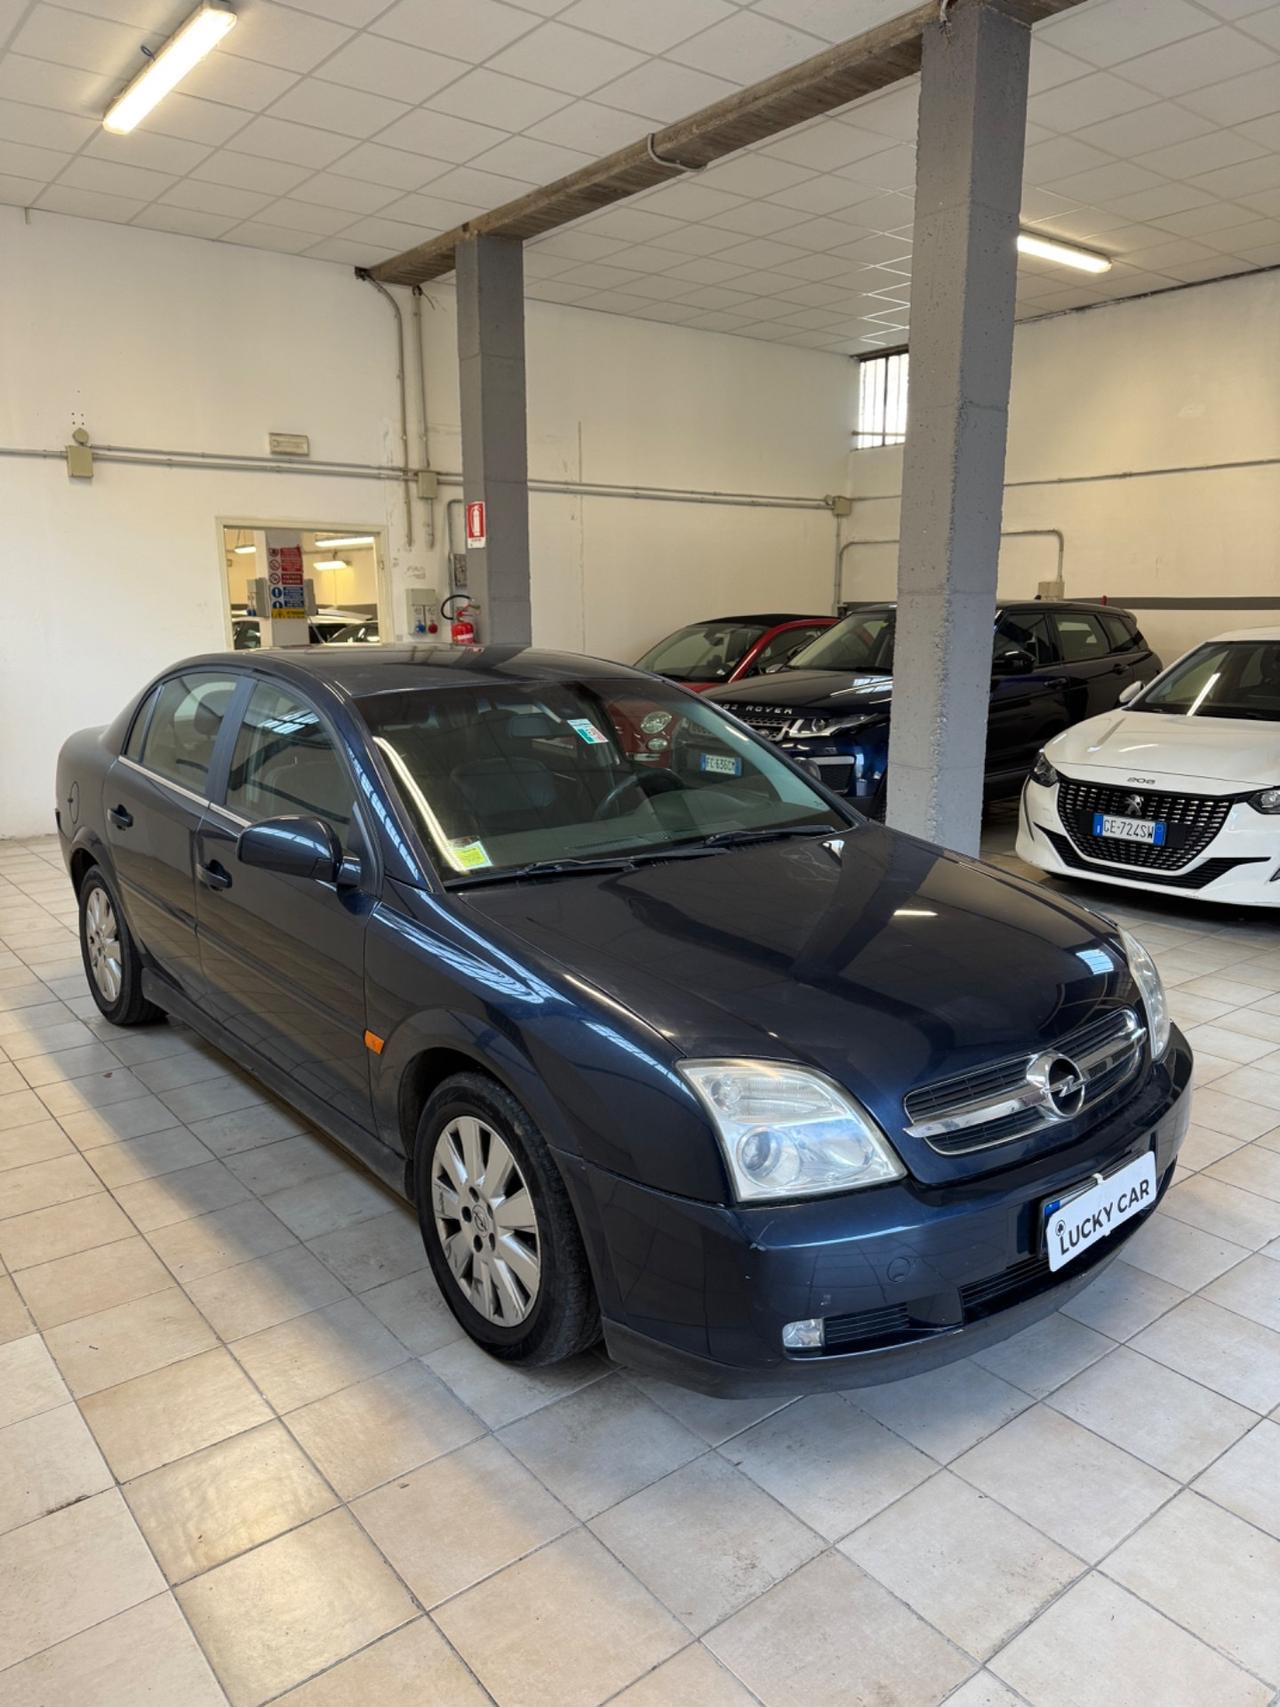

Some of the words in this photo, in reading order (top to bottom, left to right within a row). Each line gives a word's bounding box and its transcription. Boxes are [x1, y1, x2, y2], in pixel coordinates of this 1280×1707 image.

[1127, 777, 1156, 785] 208
[1059, 1202, 1113, 1256] LUCKY
[1117, 1179, 1150, 1213] CAR
